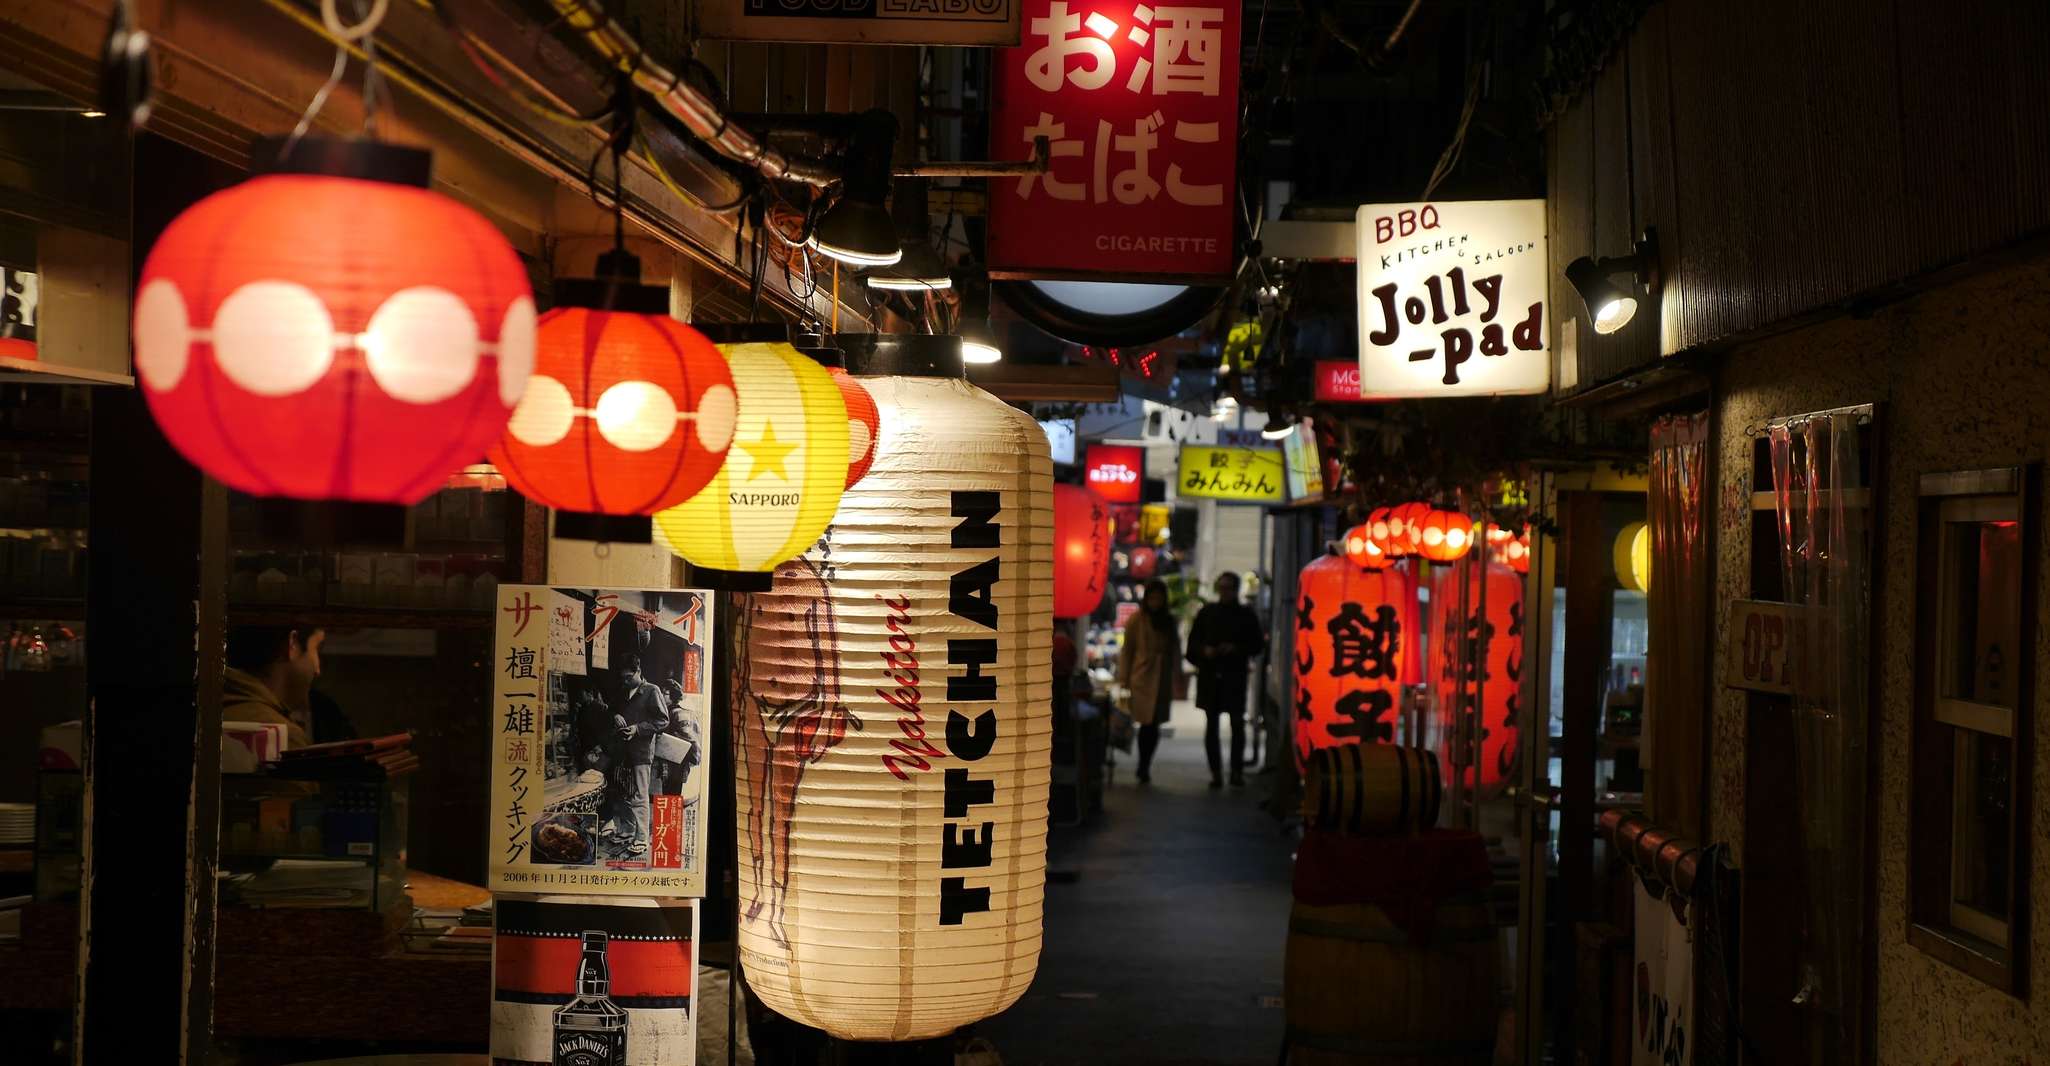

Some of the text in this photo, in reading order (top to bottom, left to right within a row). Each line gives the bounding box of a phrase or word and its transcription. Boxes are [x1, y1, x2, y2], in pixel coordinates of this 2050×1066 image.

[1024, 2, 1224, 97] お酒
[1016, 109, 1224, 206] たばこ
[1375, 204, 1441, 244] BBQ
[1095, 235, 1217, 253] CIGARETTE
[1381, 234, 1469, 270] KITCHEN
[1474, 242, 1535, 265] SALOON
[1369, 266, 1503, 347] Jolly
[1210, 452, 1256, 469] 餃子
[728, 492, 800, 507] SAPPORO
[1185, 471, 1276, 494] みんみん
[874, 593, 947, 781] Yakitori
[938, 491, 1001, 926] TETCHAN
[653, 797, 670, 867] ヨーガ入門
[559, 1035, 610, 1059] JACK DANIEL'S
